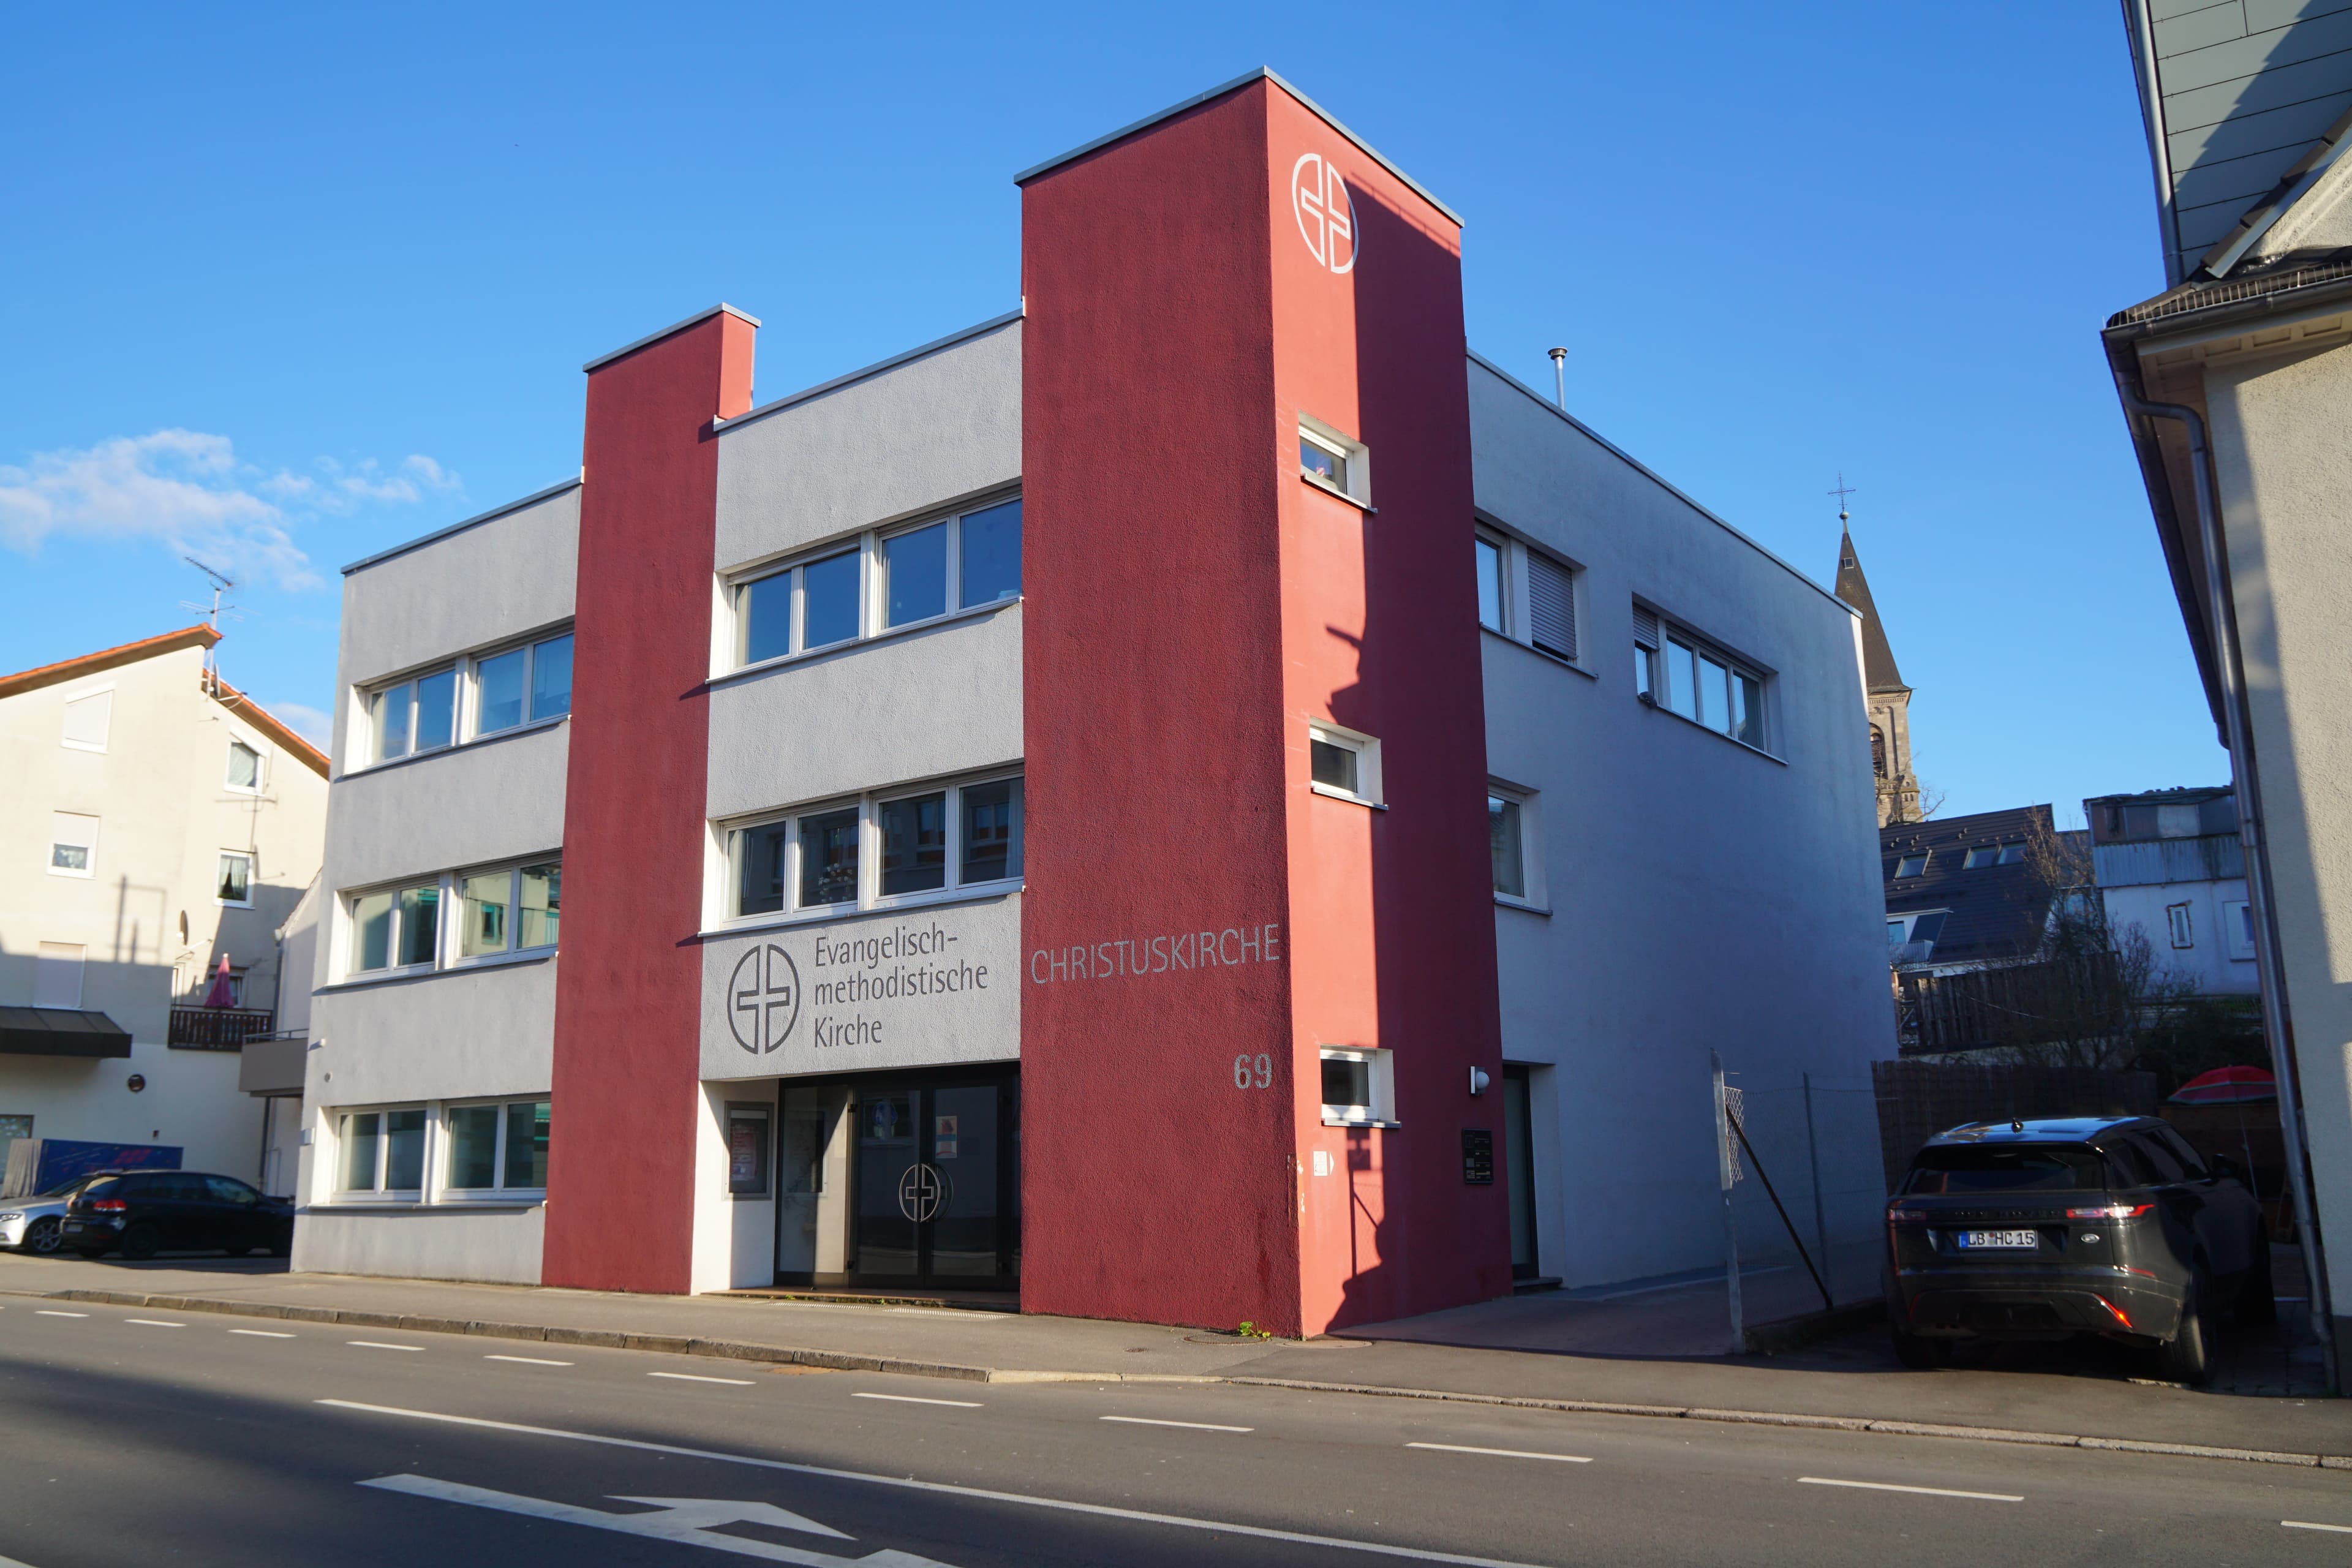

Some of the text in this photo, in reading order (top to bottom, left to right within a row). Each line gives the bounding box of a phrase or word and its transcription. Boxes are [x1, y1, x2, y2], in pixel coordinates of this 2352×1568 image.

[815, 921, 958, 970] Evangelisch-
[1031, 924, 1280, 984] CHRISTUSKIRCHE
[815, 959, 988, 1006] methodistische
[815, 1014, 883, 1048] Kirche
[1234, 1053, 1273, 1090] 69
[1969, 1232, 2035, 1245] LB HC 15
